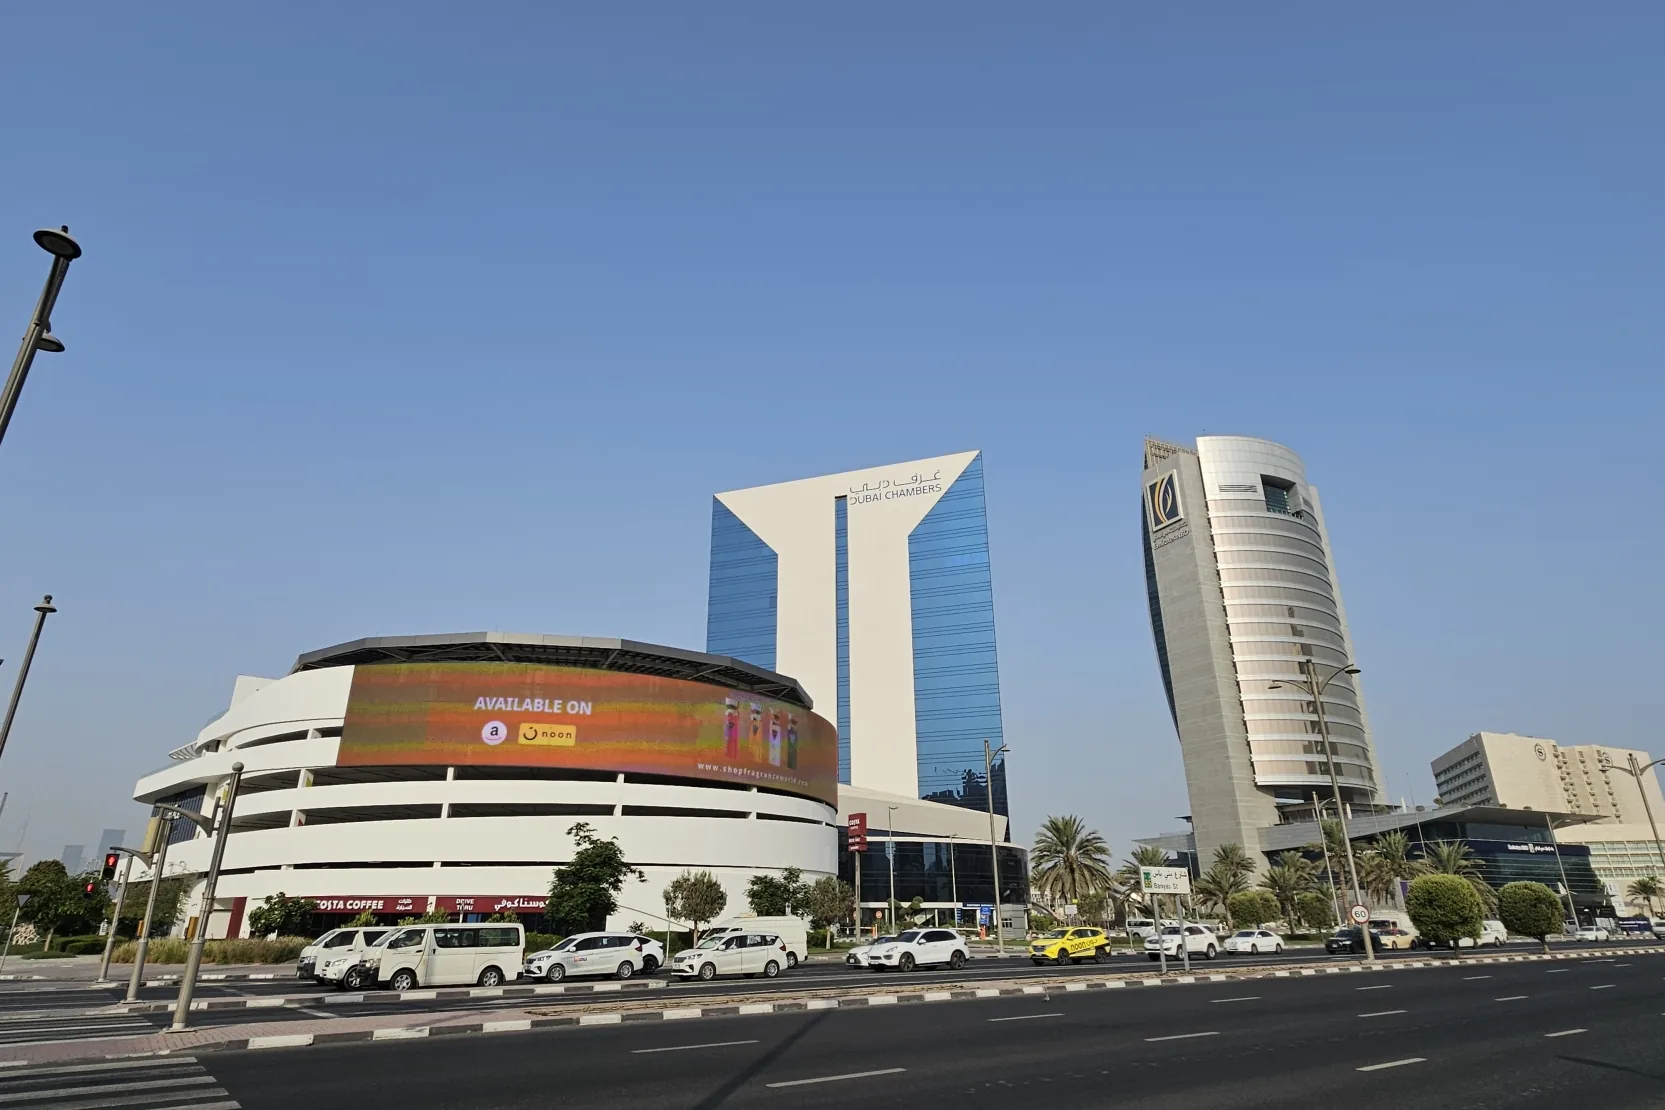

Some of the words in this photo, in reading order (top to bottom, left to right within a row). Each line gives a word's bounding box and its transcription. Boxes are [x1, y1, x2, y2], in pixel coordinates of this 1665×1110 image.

[850, 490, 883, 505] DUBAI
[884, 484, 942, 500] CHAMBERS
[474, 696, 562, 713] AVAILABLE
[566, 700, 592, 716] ON
[490, 726, 499, 736] a
[541, 730, 572, 739] noon
[346, 900, 384, 910] COFFEE
[1354, 910, 1367, 918] 60
[1070, 941, 1086, 951] noon
